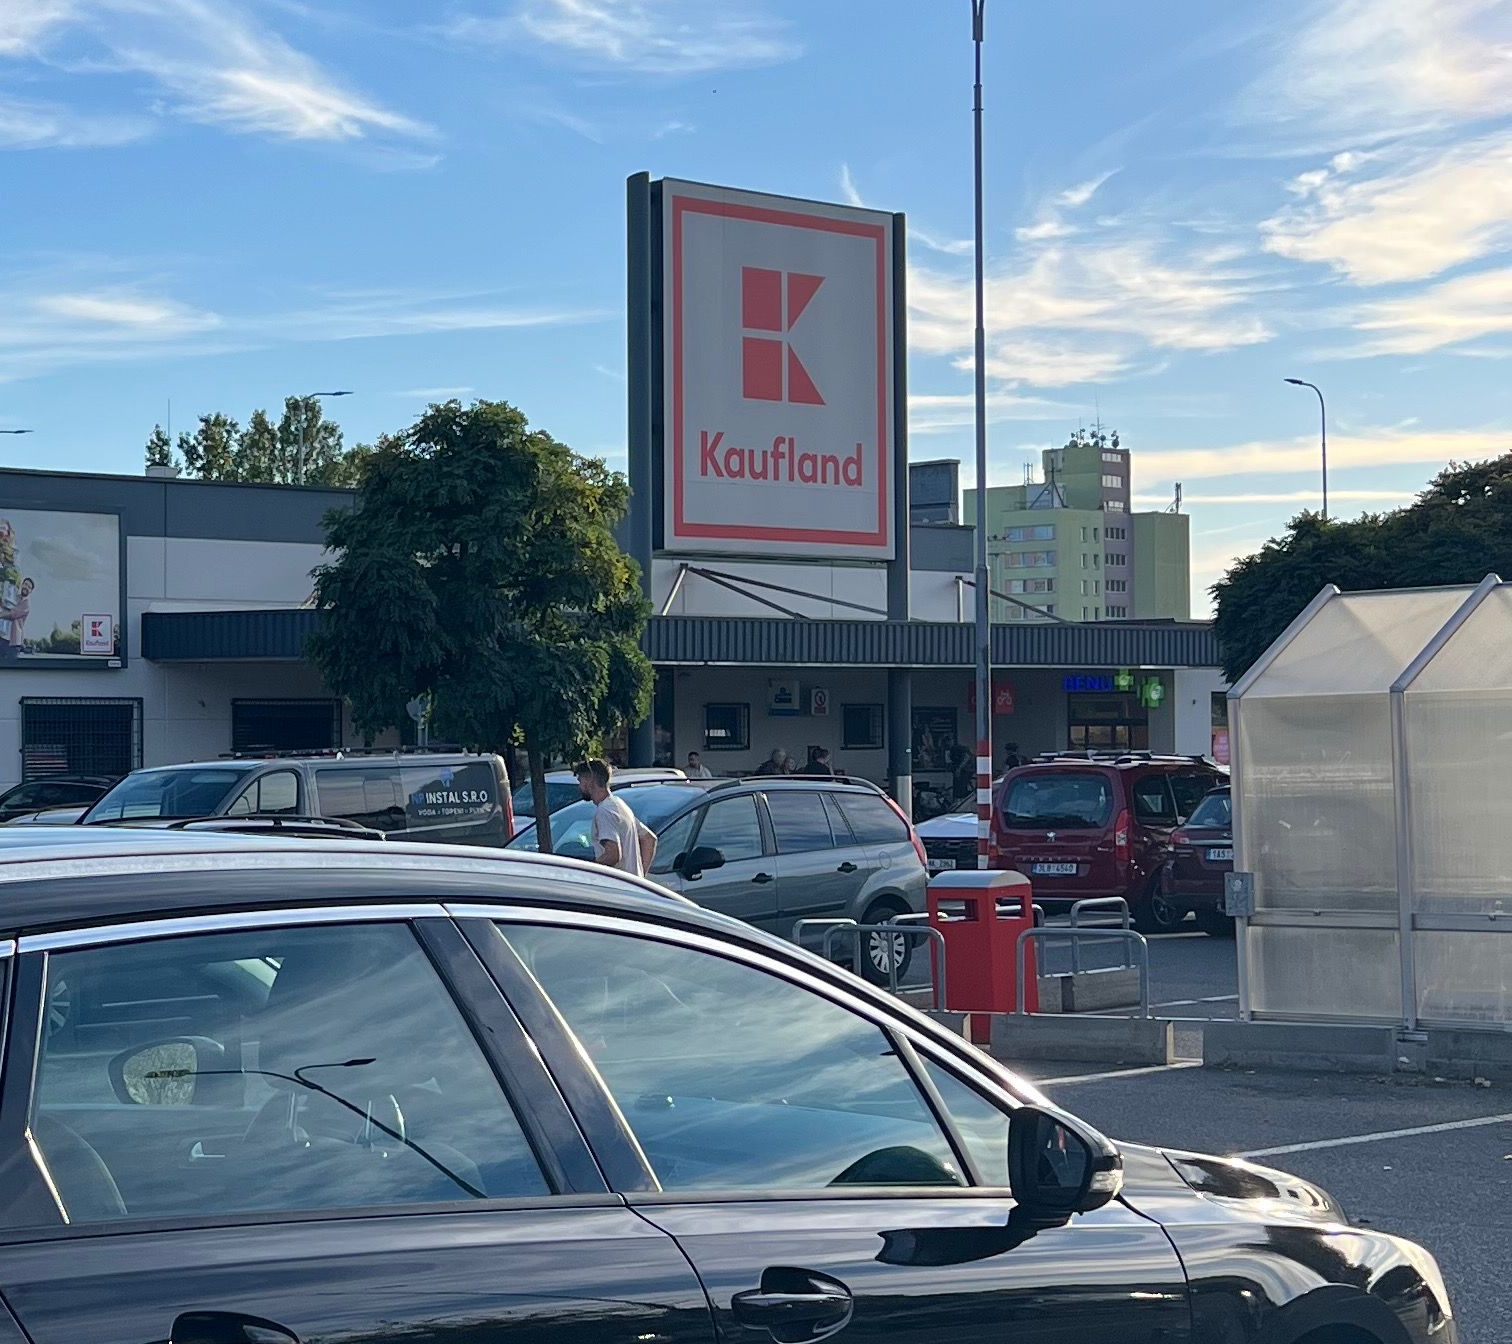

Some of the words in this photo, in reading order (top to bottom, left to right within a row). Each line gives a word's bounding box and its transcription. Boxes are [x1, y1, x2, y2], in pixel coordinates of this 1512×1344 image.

[699, 430, 863, 487] Kaufland
[425, 792, 461, 805] INSTAL
[462, 790, 488, 803] S.R.O
